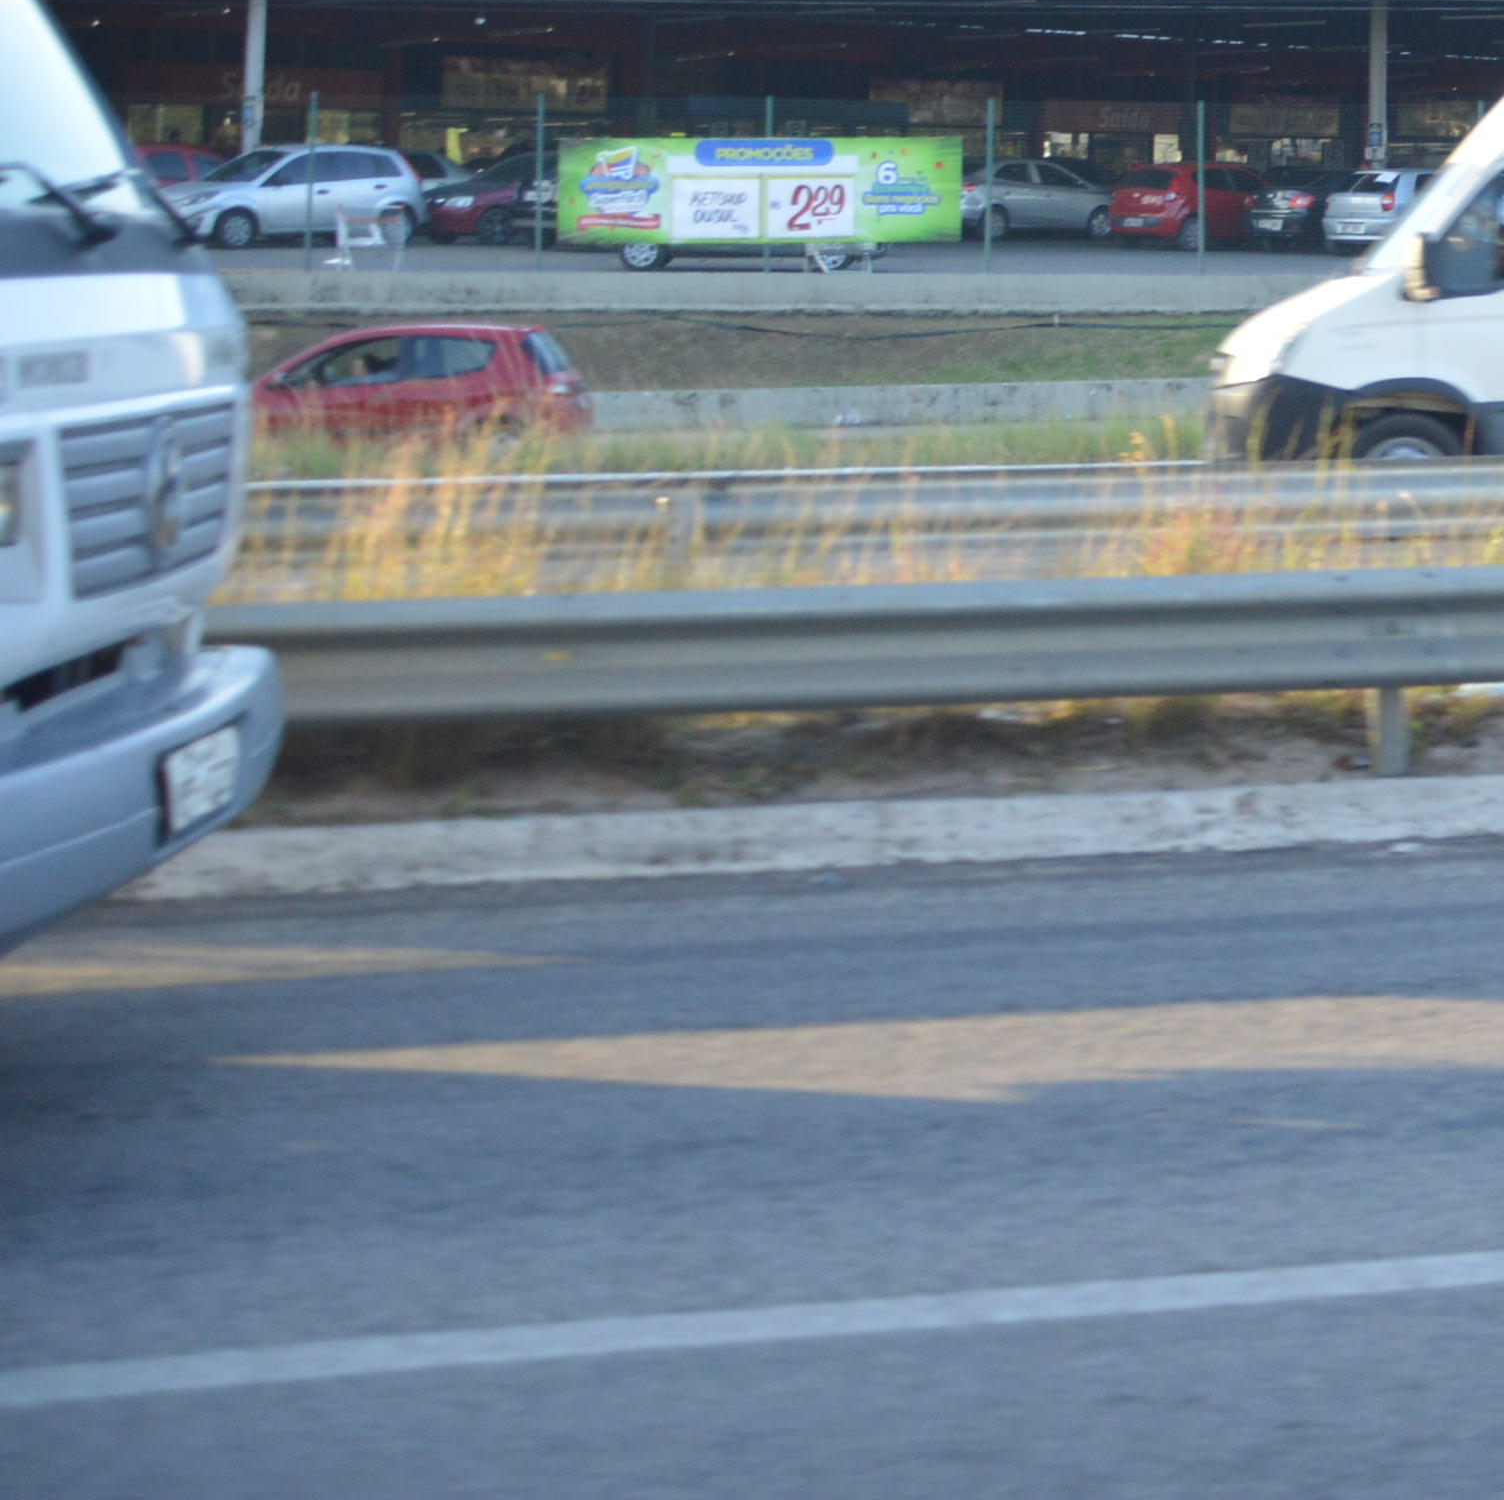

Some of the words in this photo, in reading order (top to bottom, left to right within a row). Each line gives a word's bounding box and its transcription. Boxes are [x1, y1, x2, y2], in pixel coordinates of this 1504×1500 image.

[221, 69, 301, 100] Sda
[715, 145, 814, 162] PROMOÇÕES
[877, 162, 897, 185] 6
